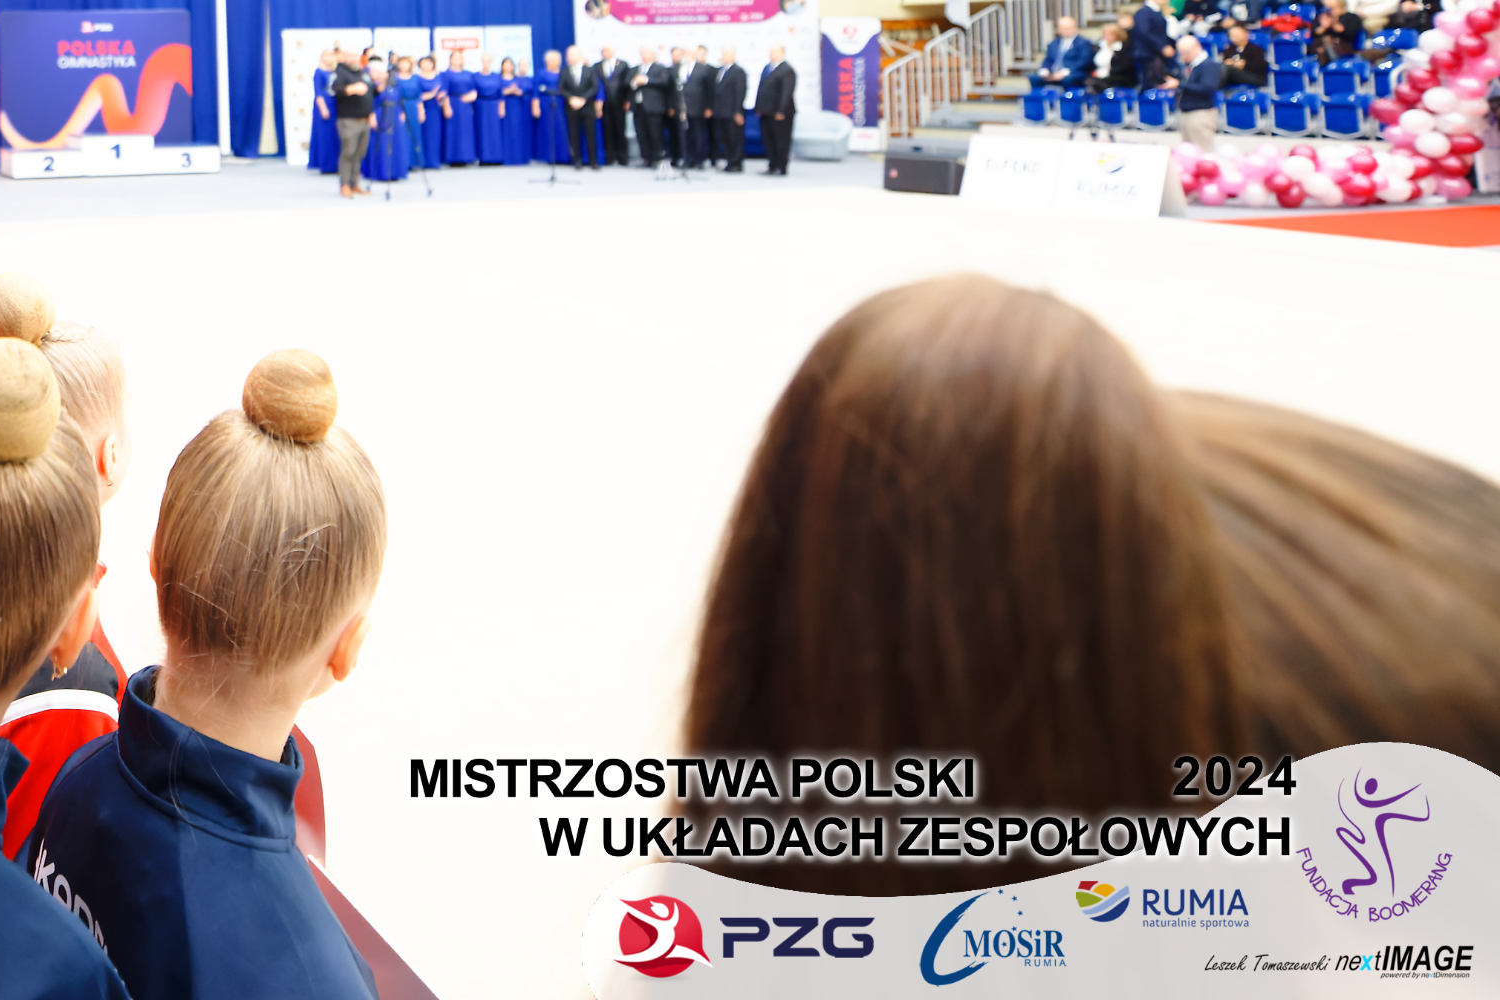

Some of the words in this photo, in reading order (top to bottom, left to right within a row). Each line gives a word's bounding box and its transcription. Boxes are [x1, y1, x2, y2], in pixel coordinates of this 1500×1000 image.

[57, 40, 136, 56] POLSKA
[57, 55, 137, 69] GIMNASTYKA
[838, 57, 854, 116] OLSKA
[110, 144, 121, 158] 1
[44, 156, 54, 171] 2
[181, 153, 192, 168] 3
